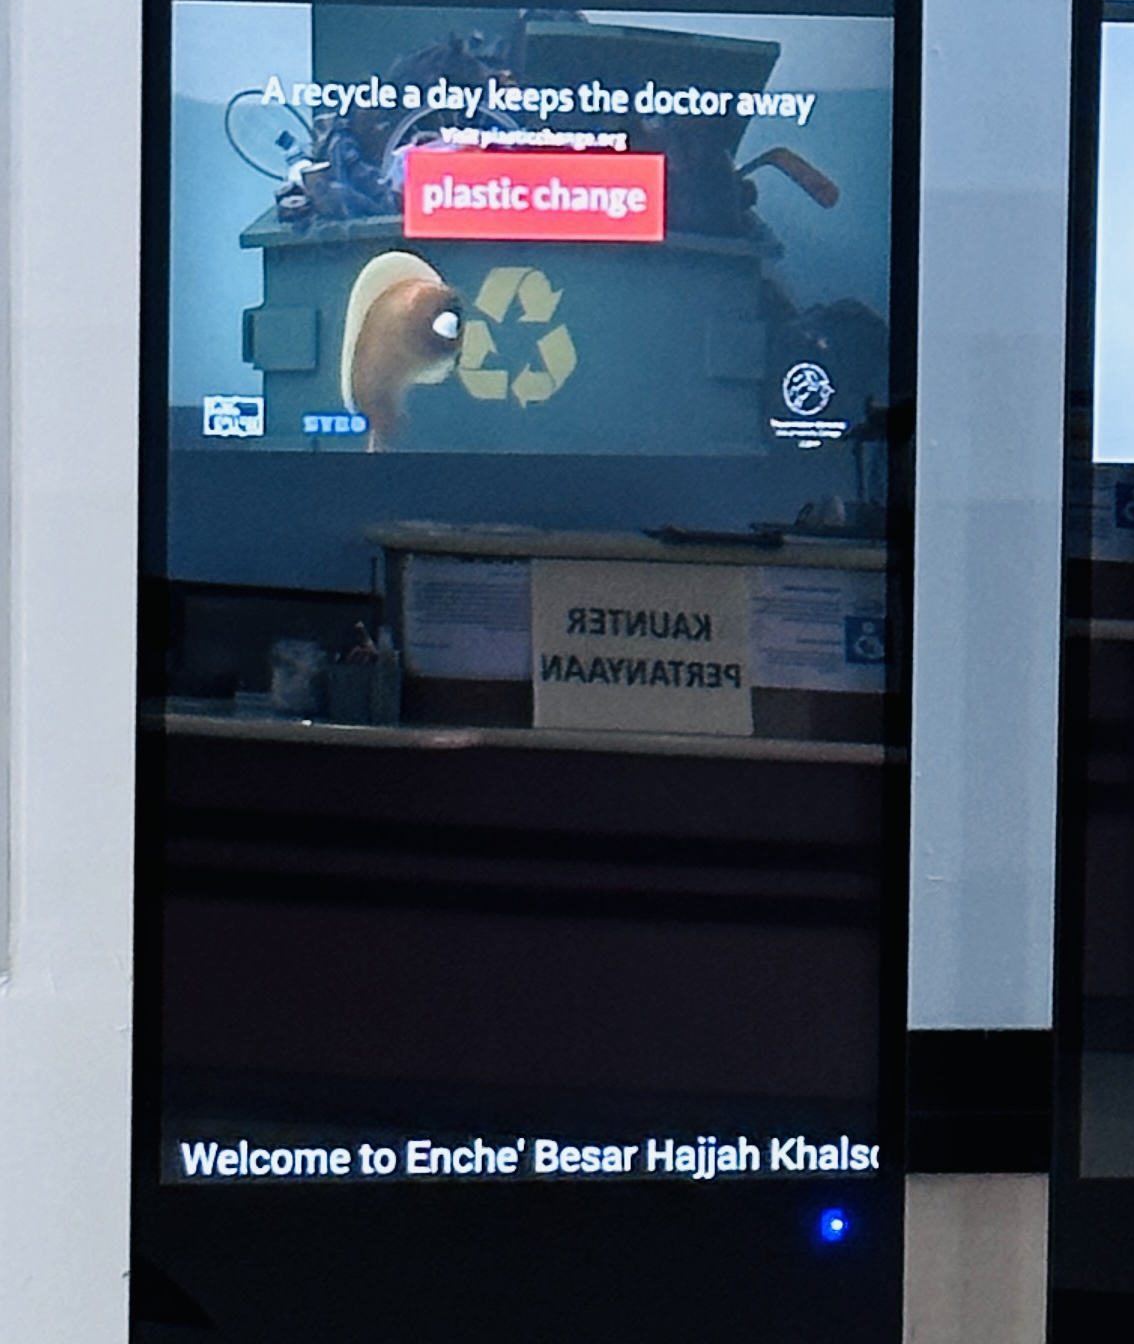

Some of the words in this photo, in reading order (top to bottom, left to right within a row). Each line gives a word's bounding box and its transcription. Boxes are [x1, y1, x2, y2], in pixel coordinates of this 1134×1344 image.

[261, 76, 286, 105] A
[292, 76, 397, 116] recycle
[403, 84, 420, 108] a
[427, 78, 483, 118] day
[489, 78, 575, 120] keeps
[578, 80, 628, 113] the
[634, 80, 732, 115] doctor
[736, 91, 815, 125] away
[423, 176, 529, 214] plastic
[533, 177, 647, 218] change
[181, 1140, 351, 1175] Welcome
[359, 1143, 397, 1173] to
[407, 1138, 525, 1174] Enche'
[535, 1139, 638, 1173] Besar
[648, 1136, 760, 1179] Hajjah
